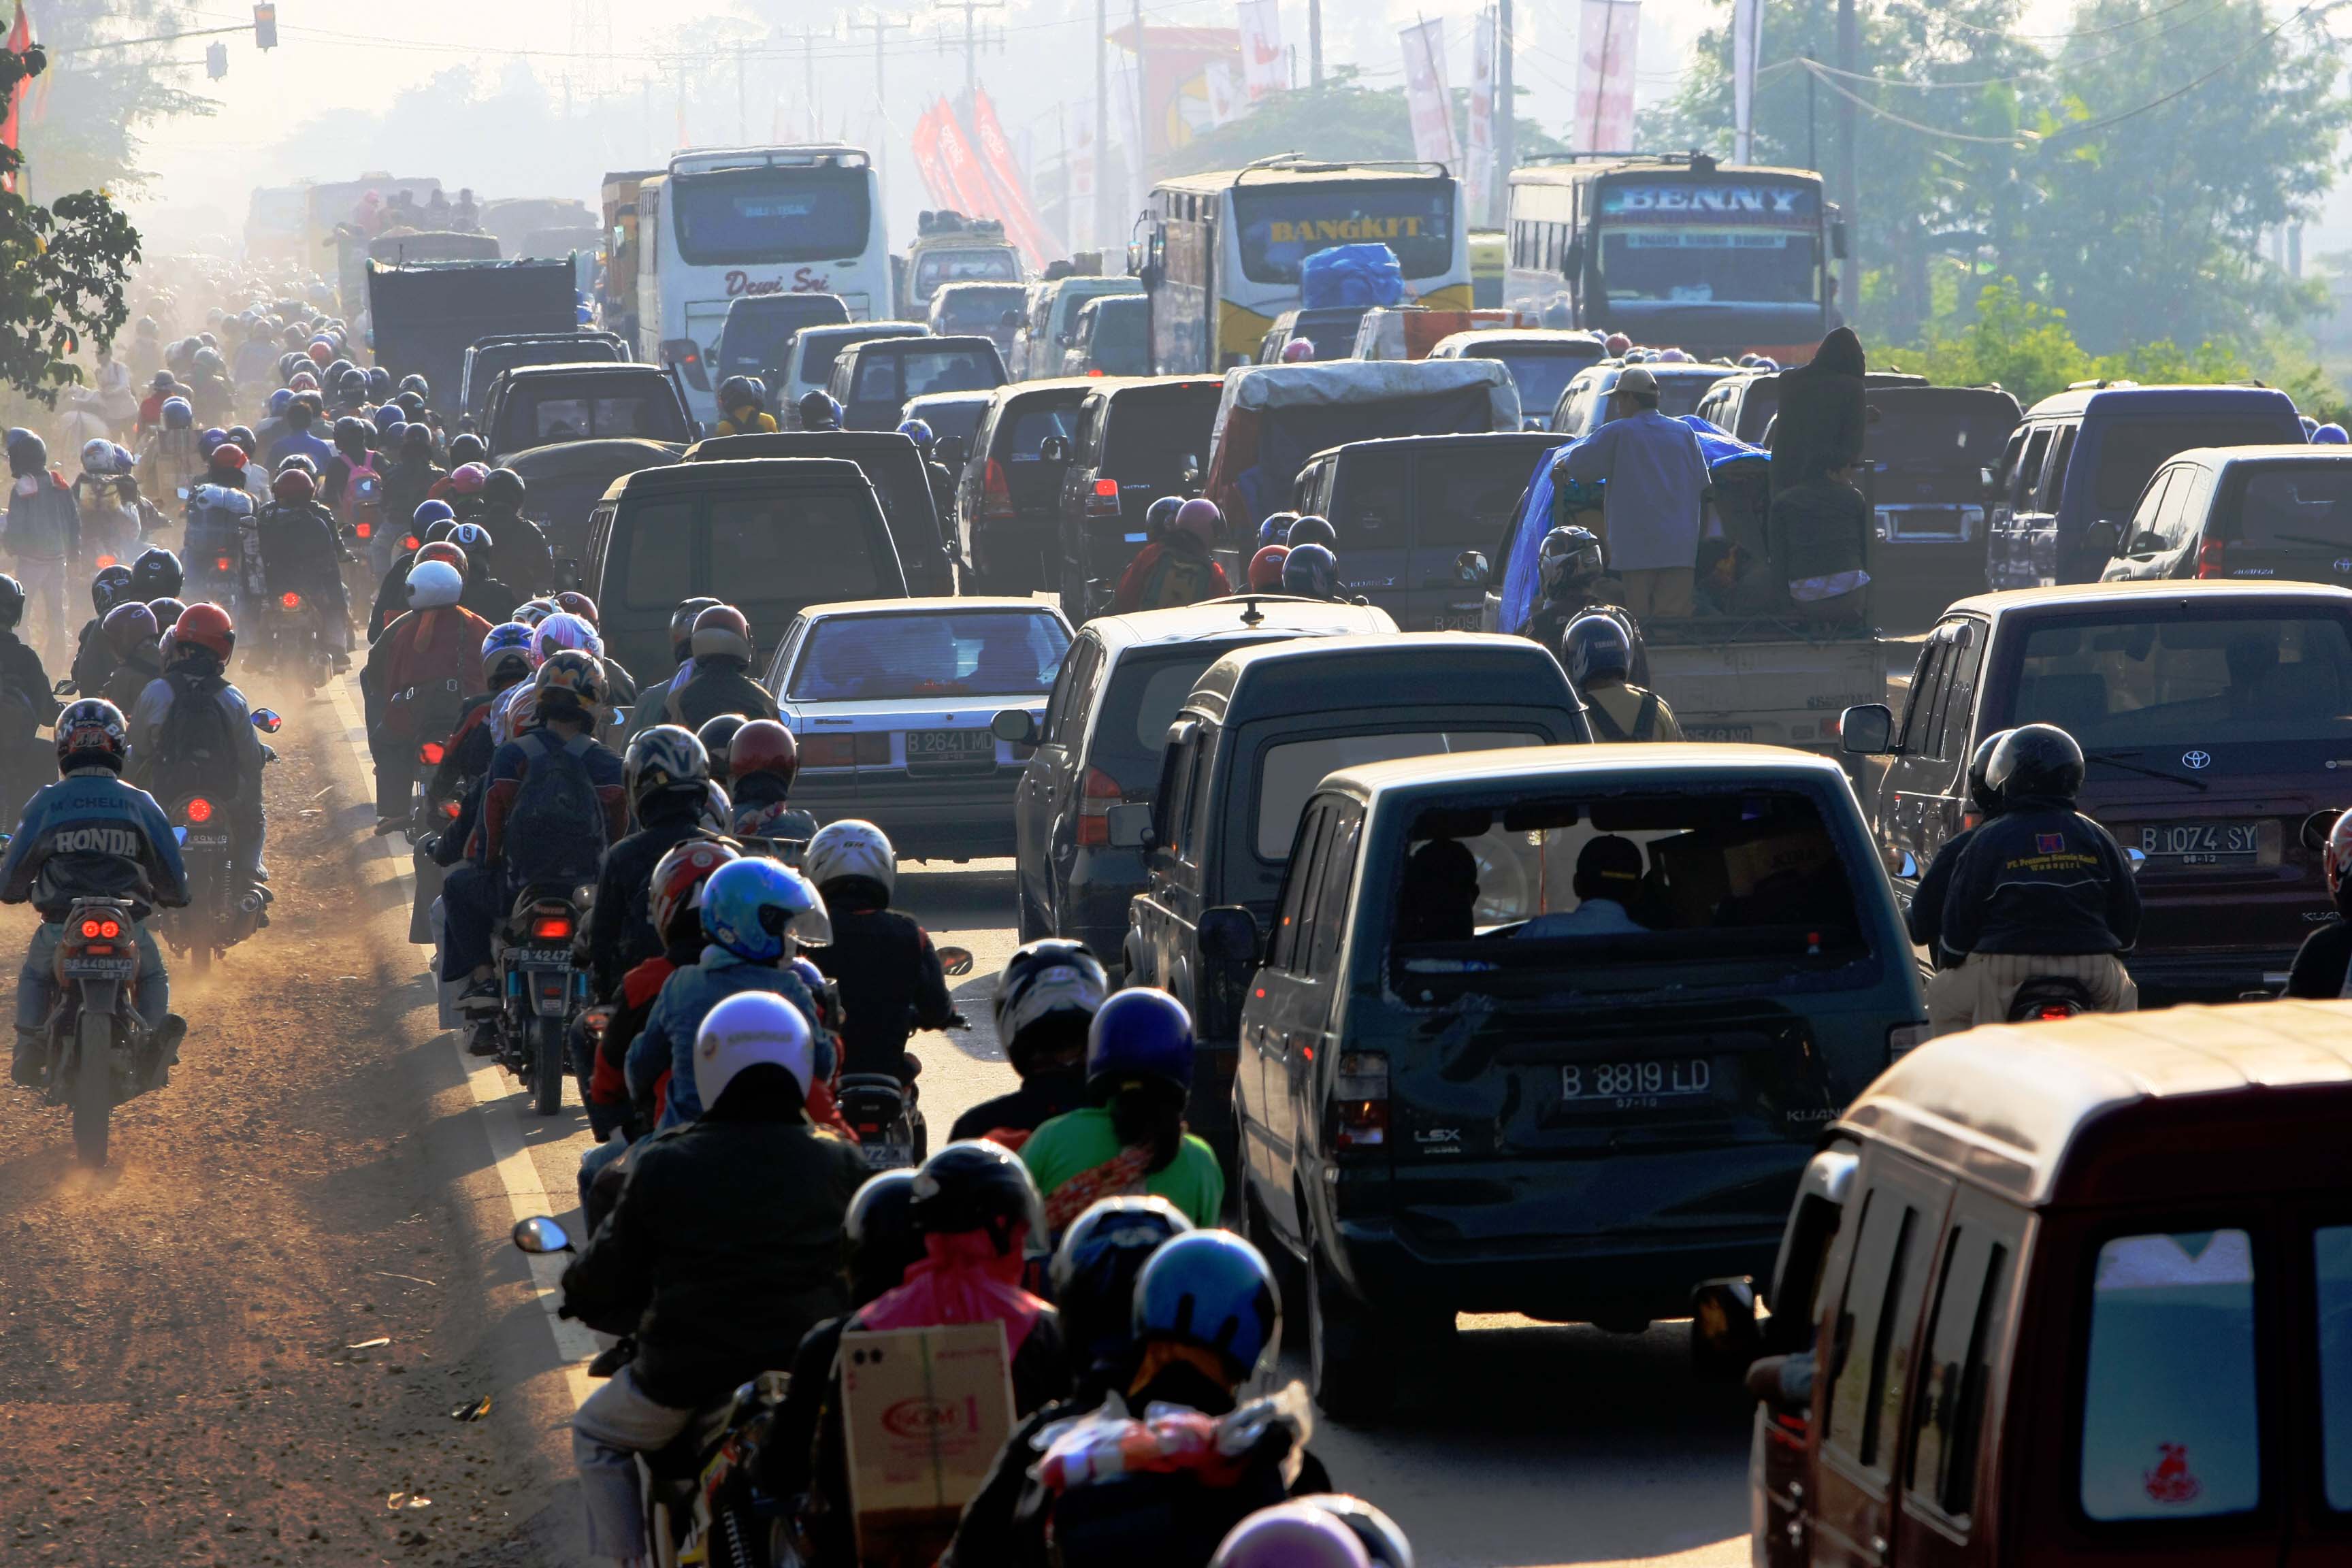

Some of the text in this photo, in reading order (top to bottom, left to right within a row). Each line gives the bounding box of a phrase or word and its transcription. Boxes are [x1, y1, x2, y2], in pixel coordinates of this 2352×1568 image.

[1622, 185, 1805, 212] BENNY
[1270, 216, 1421, 243] BANGKIT
[725, 269, 830, 295] Dewi Sri
[908, 732, 995, 752] B 2641 MD
[55, 828, 137, 857] HONDA
[2142, 824, 2257, 852] B 1074 SY
[521, 949, 529, 961] B
[1563, 1059, 1710, 1097] B 8819 LD
[1786, 1109, 1843, 1122] KIJAN
[1414, 1128, 1461, 1143] LSX
